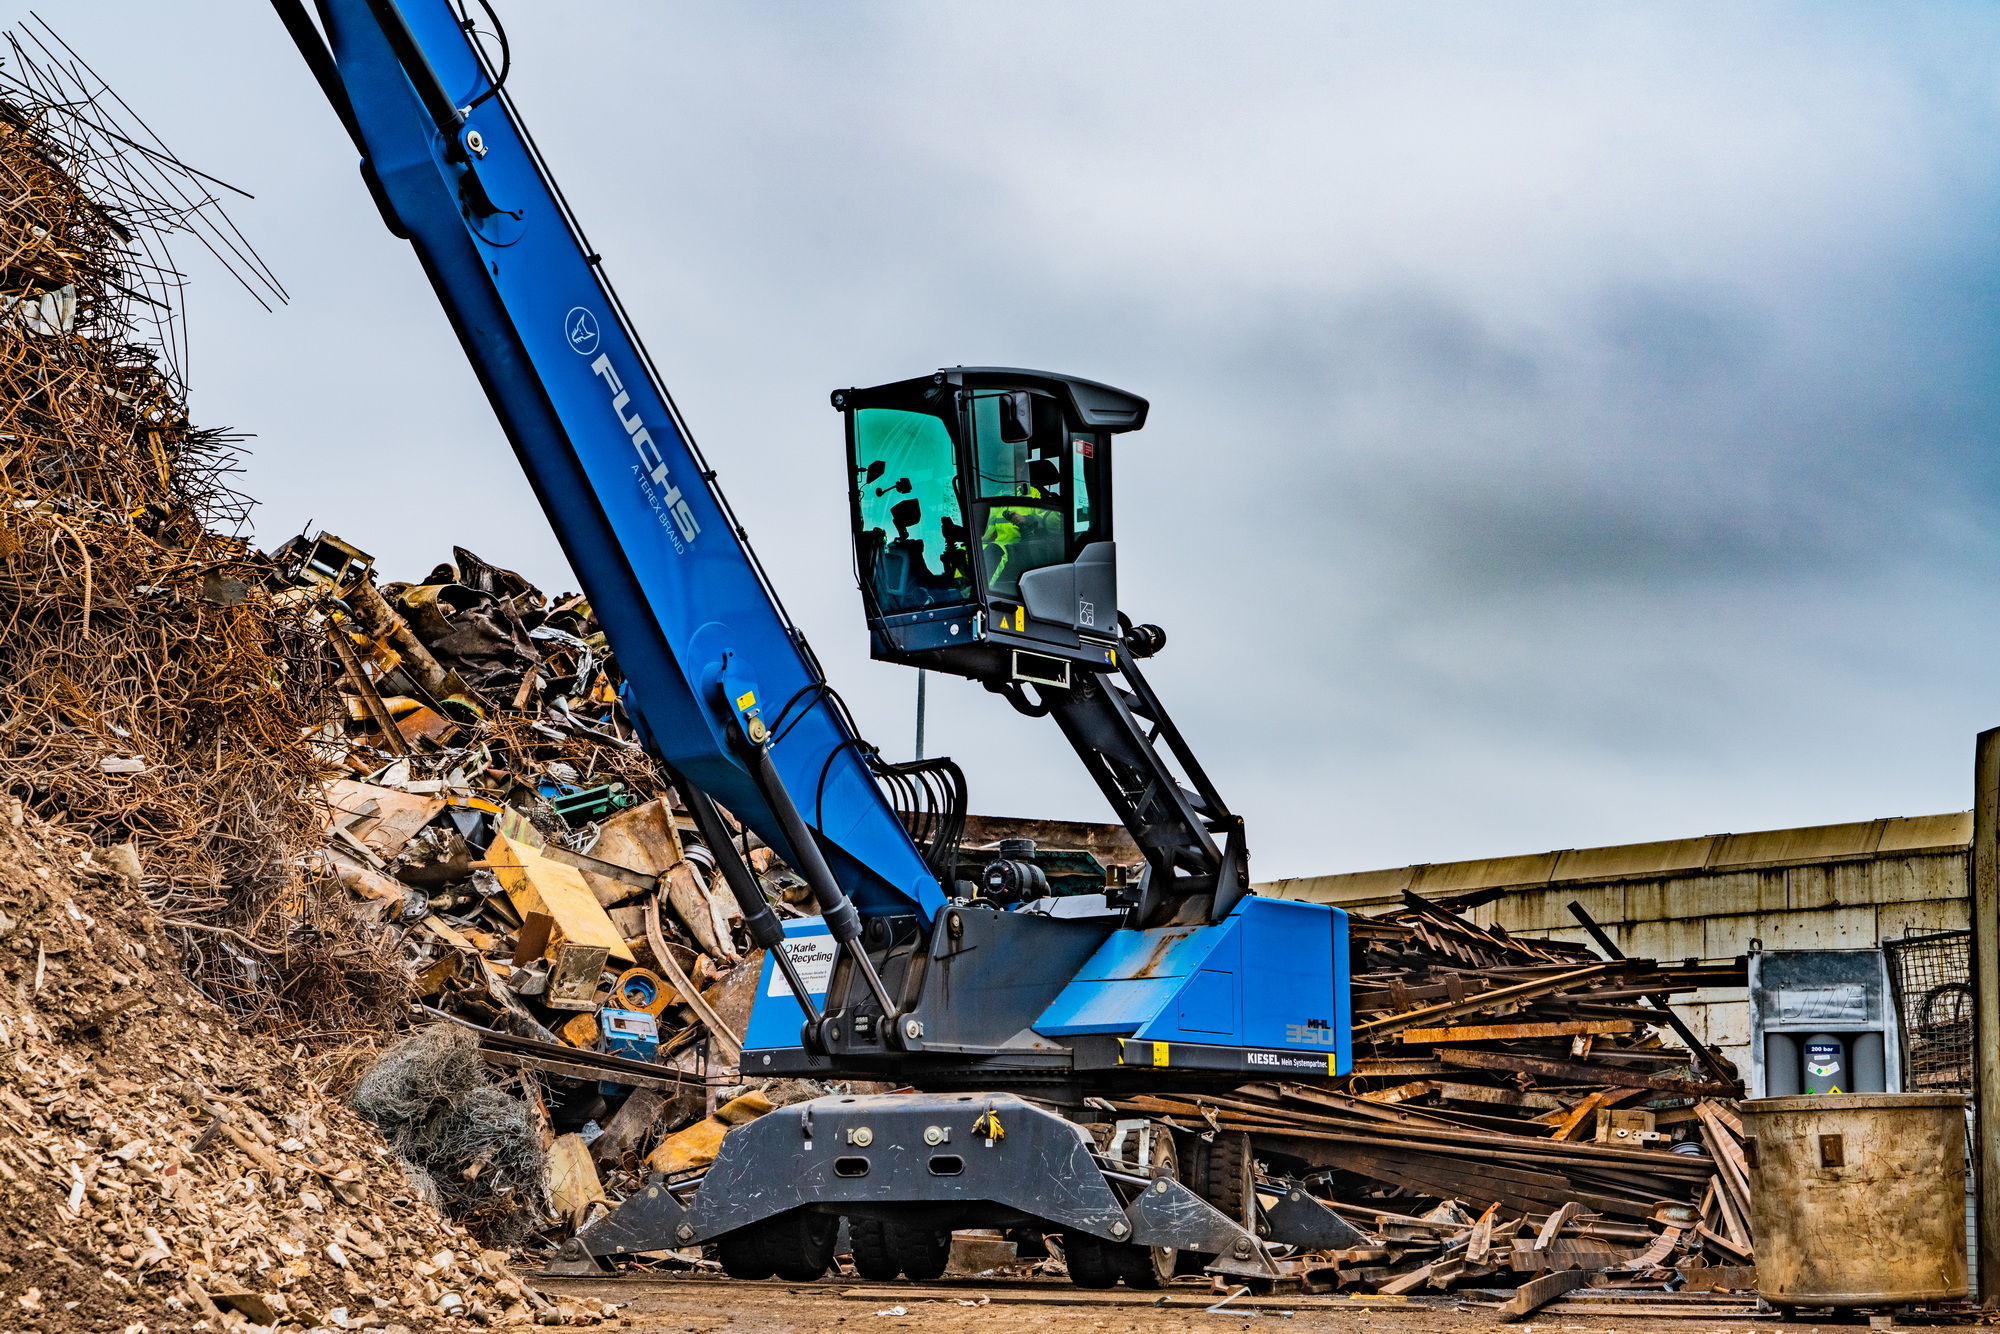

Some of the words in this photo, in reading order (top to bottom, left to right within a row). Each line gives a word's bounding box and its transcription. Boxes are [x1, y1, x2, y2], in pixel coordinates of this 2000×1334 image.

[591, 352, 701, 544] FUCHS
[630, 463, 639, 476] A
[638, 472, 662, 514] TEREX
[659, 513, 684, 555] BRAND
[793, 943, 816, 953] Karle
[791, 952, 832, 963] Recycling
[1307, 1018, 1331, 1030] MHL
[1286, 1024, 1334, 1045] 350
[1247, 1052, 1280, 1066] KIESEL
[1281, 1057, 1293, 1066] Mein
